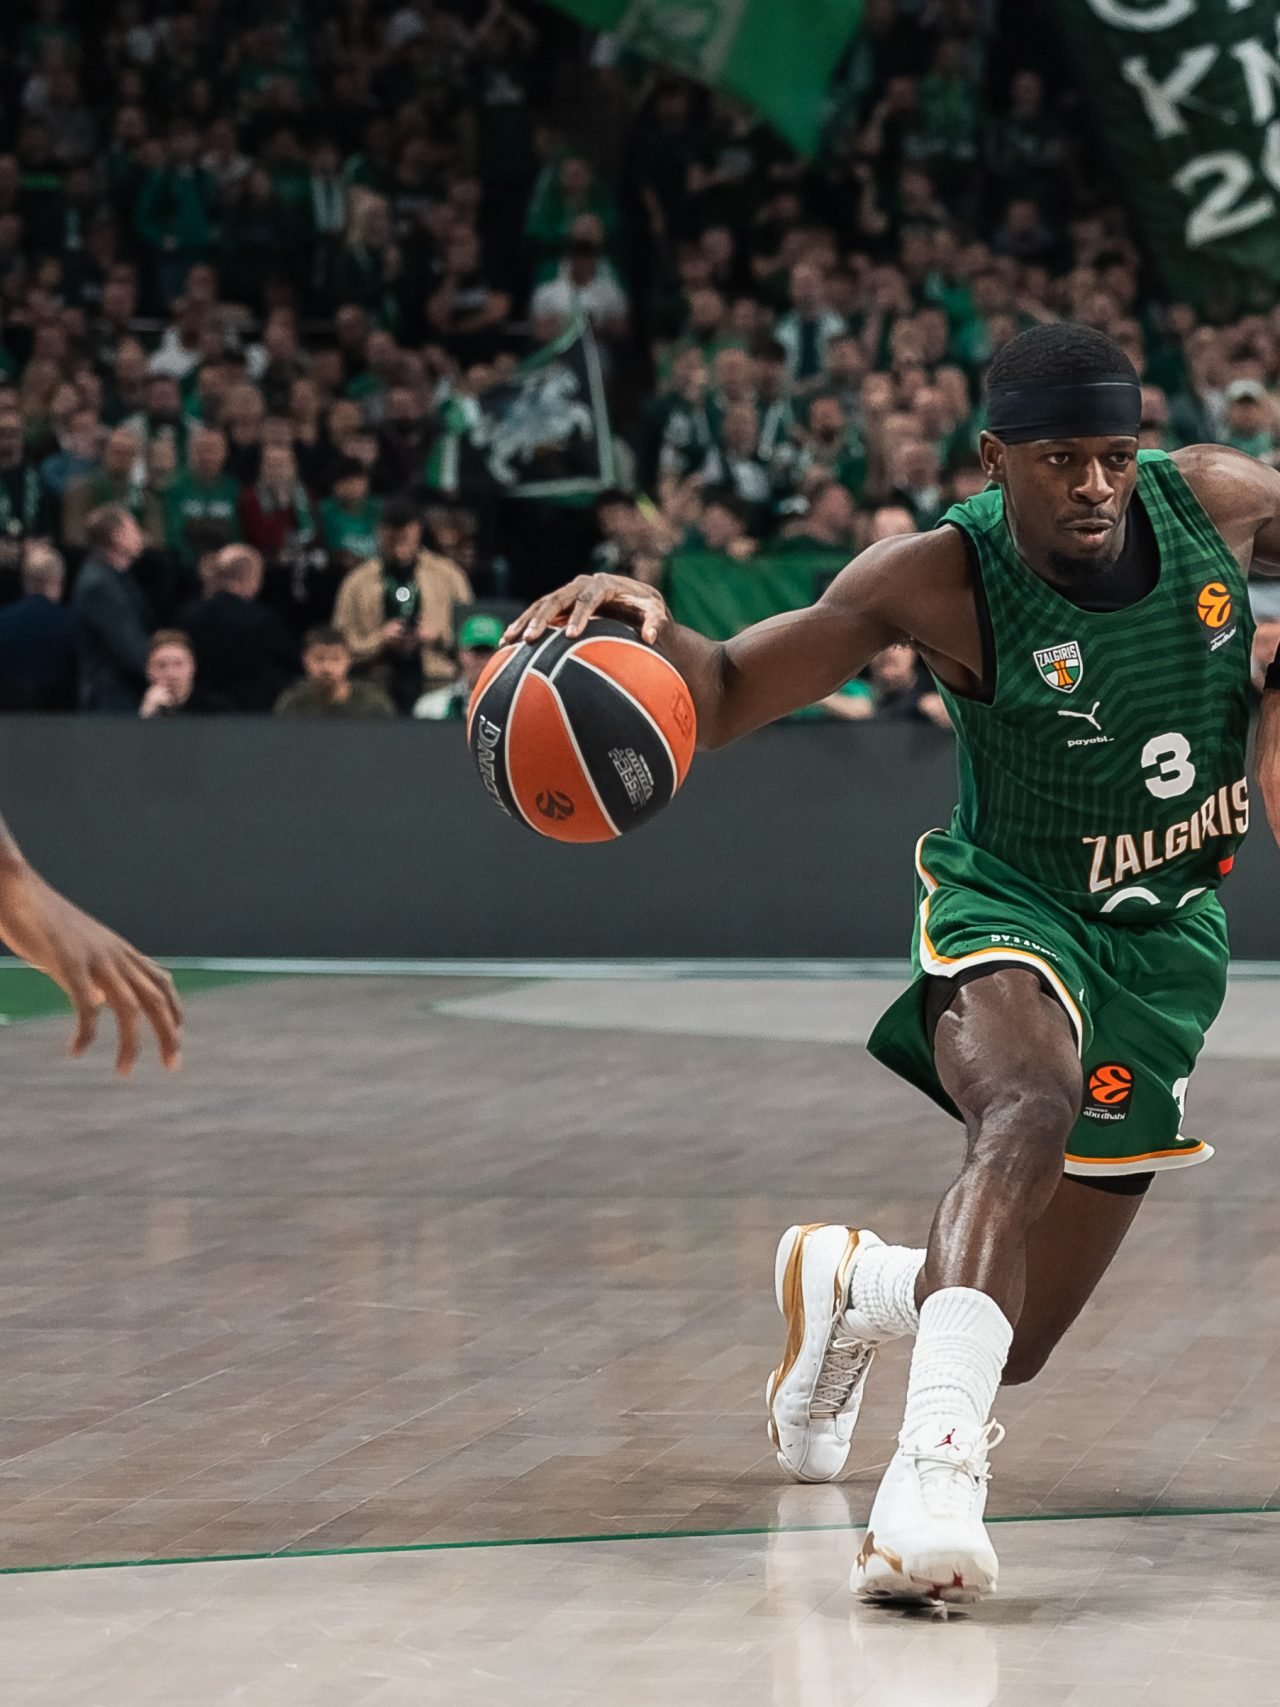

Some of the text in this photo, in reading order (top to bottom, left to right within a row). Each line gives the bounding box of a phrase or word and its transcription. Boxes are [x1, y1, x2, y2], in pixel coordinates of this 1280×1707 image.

[1140, 732, 1196, 799] 3
[1082, 775, 1250, 893] ZALGIRIS
[1101, 1112, 1126, 1120] dhabi
